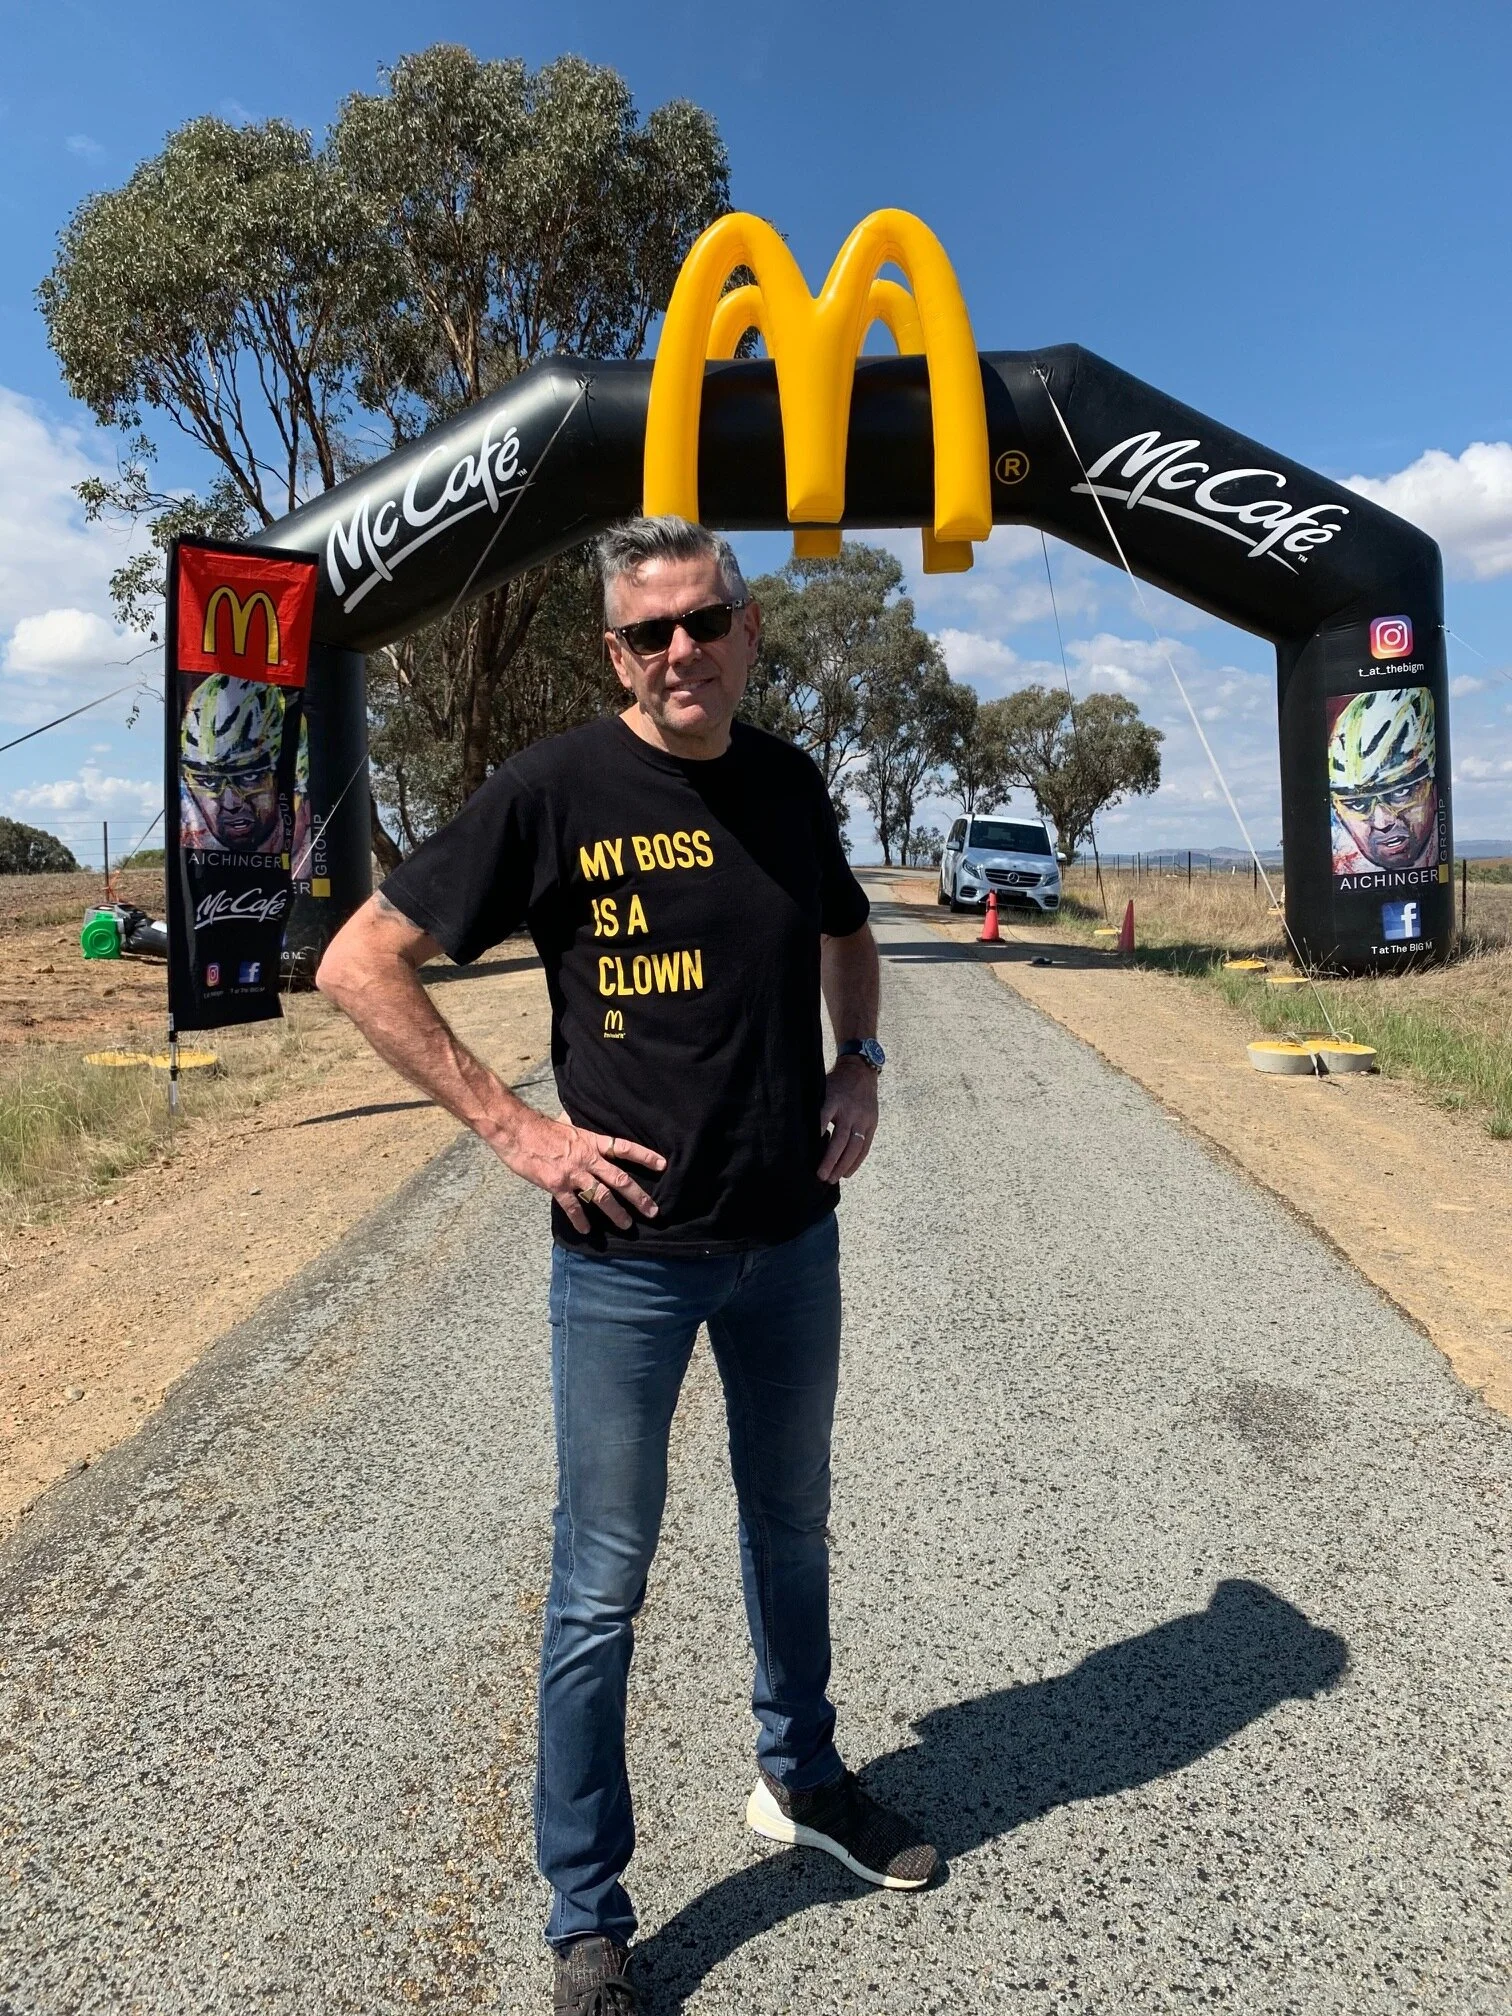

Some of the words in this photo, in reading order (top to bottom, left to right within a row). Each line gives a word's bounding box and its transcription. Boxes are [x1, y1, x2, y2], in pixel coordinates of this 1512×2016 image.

[326, 410, 521, 597] McCafé
[1087, 430, 1349, 558] McCafé
[1358, 662, 1425, 677] t_at_thebigm
[314, 814, 328, 875] GROUP
[1439, 799, 1448, 861] GROUP
[188, 853, 281, 869] AICHINGER
[579, 838, 624, 882] MY
[632, 830, 714, 871] BOSS
[1340, 871, 1439, 890] AICHINGER
[196, 888, 287, 925] McCafé
[591, 898, 619, 937] IS
[628, 894, 649, 936] A
[1371, 946, 1378, 954] T
[1379, 946, 1389, 954] at
[1391, 945, 1407, 953] The
[1410, 943, 1424, 951] BIG
[1425, 941, 1433, 949] M
[598, 950, 704, 996] CLOWN
